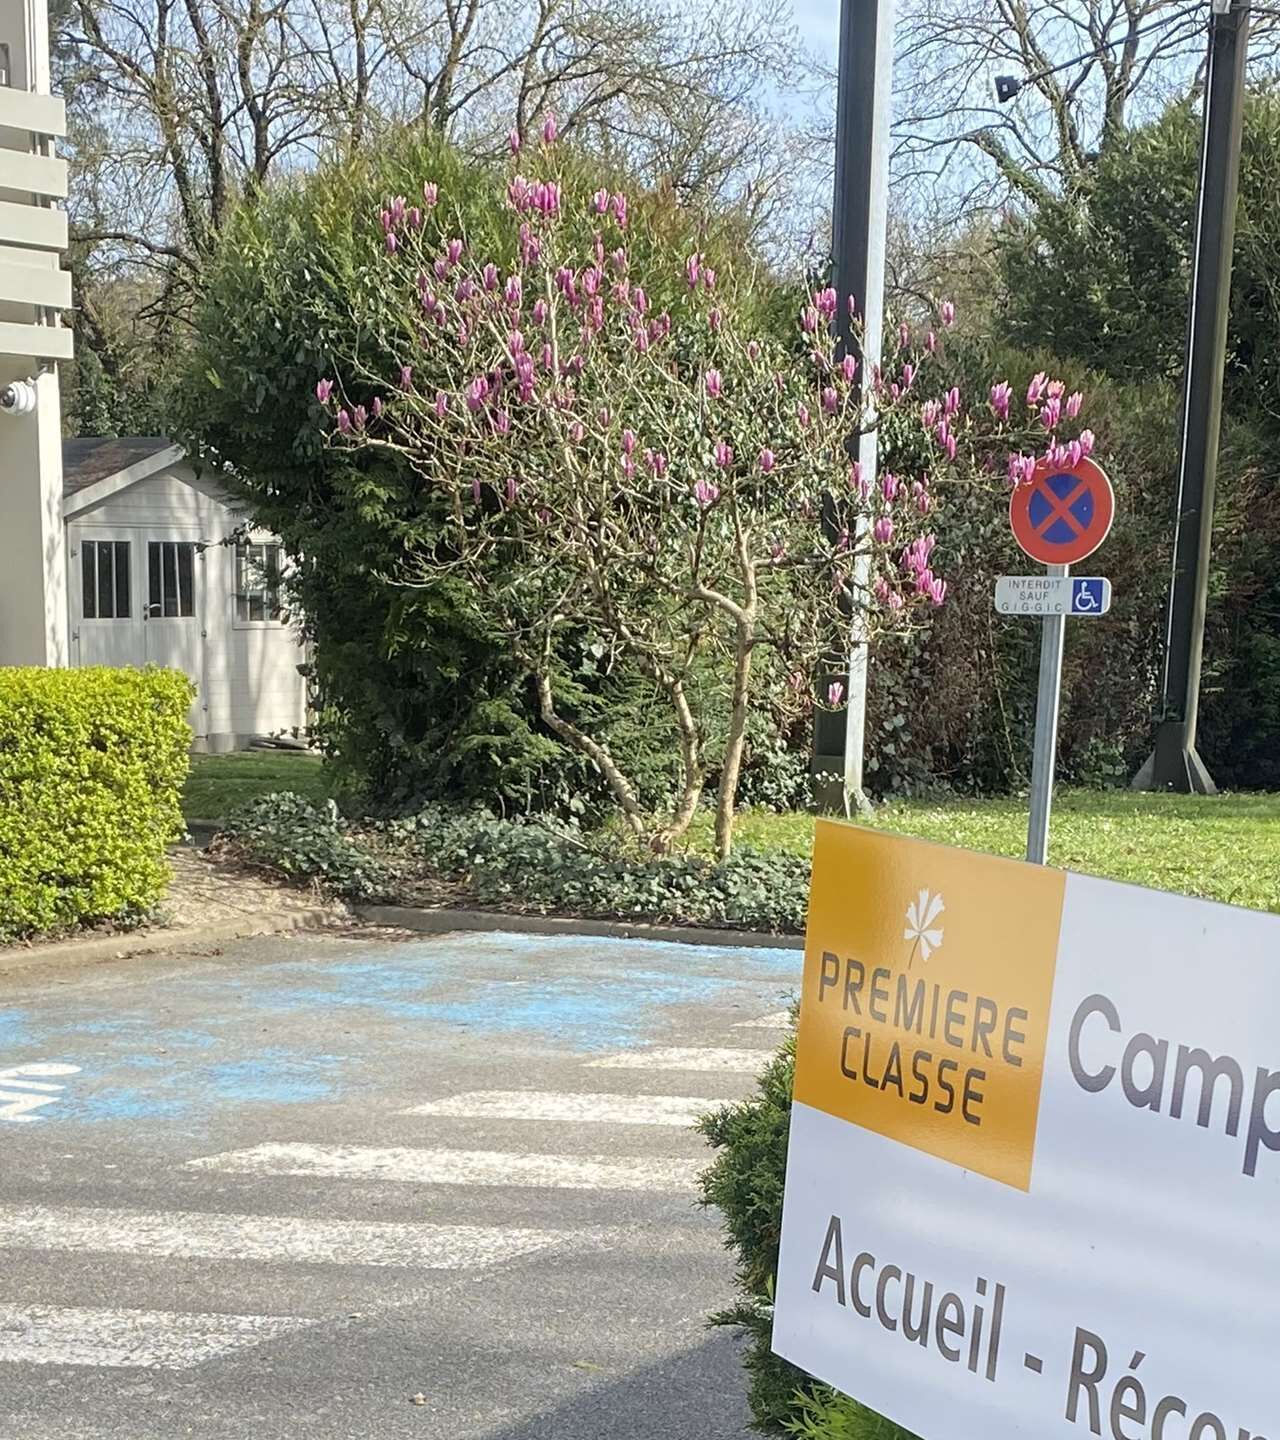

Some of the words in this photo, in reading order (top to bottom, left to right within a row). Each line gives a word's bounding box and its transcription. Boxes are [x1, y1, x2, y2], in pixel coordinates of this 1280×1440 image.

[1008, 580, 1061, 590] INTERDIT
[1019, 591, 1049, 601] SAUF
[818, 950, 1029, 1068] PREMIERE
[840, 1025, 987, 1127] CLASSE
[811, 1214, 1006, 1383] Accueil
[1024, 1352, 1044, 1375] -
